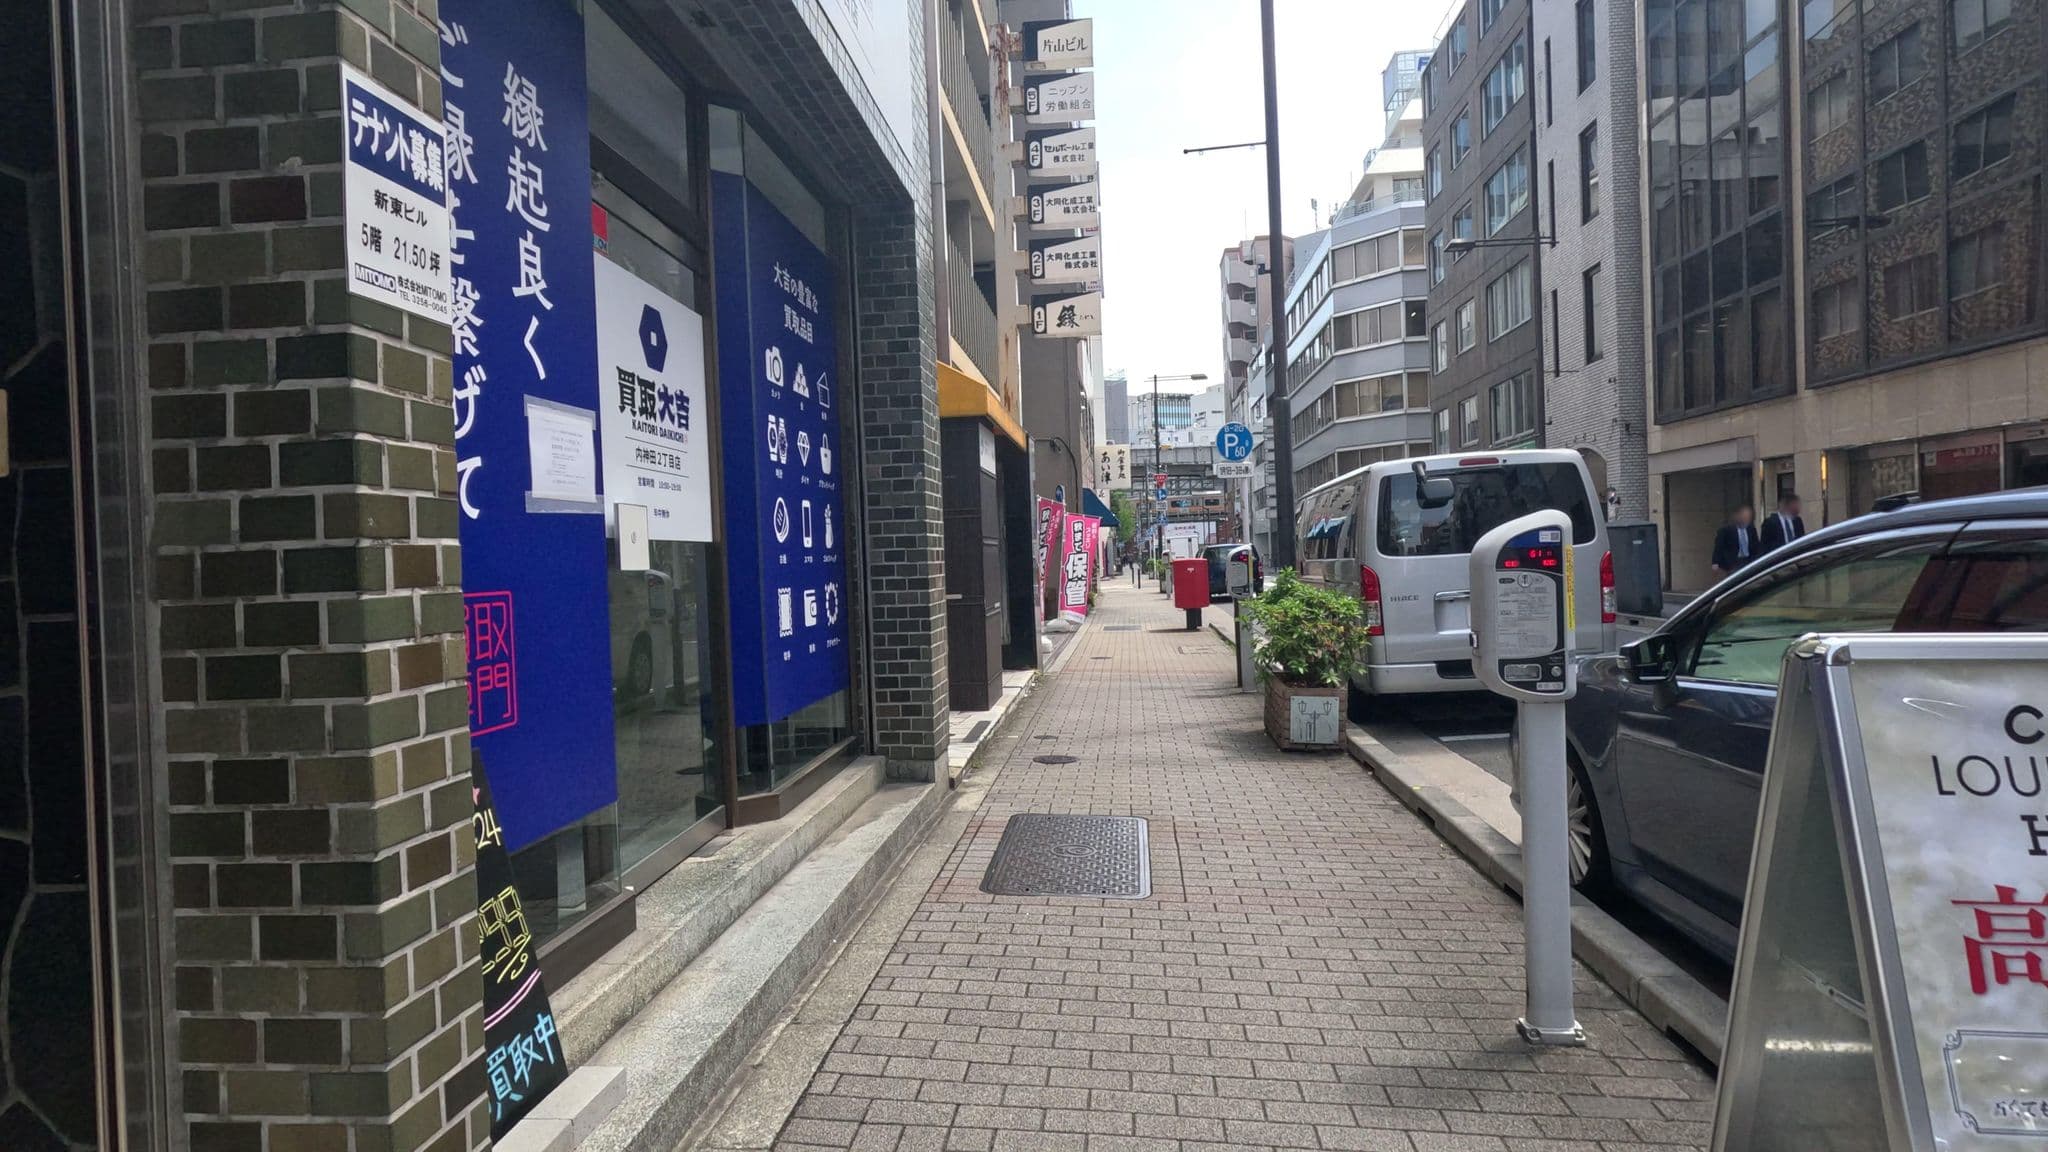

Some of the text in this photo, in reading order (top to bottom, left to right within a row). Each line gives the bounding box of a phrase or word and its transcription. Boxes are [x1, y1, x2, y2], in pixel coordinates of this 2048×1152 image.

[1042, 37, 1088, 52] 片山ビル
[1027, 90, 1037, 112] 5F
[1045, 98, 1092, 112] 労働組合
[350, 97, 444, 193] テナント募集
[1030, 143, 1040, 165] 4F
[1053, 154, 1086, 163] 株式会社
[374, 189, 428, 228] 新東ビル
[502, 61, 554, 381] 縁起良く
[1031, 197, 1042, 221] 3F
[1063, 204, 1096, 214] 株式会社
[361, 223, 383, 256] 5階
[1032, 252, 1042, 275] 2F
[1065, 259, 1098, 270] 株式会社
[355, 265, 396, 291] MITOMO
[398, 275, 448, 303] 株式会社MITOMO
[773, 262, 819, 314] 大吉の豊富な
[400, 291, 411, 302] TEL
[783, 304, 814, 345] 買取品目
[1034, 309, 1044, 333] 1F
[616, 366, 690, 431] 買取大吉
[632, 419, 684, 444] KAITORI DAIKICHI
[1224, 433, 1246, 458] P 60
[635, 446, 681, 471] 内神田2丁目店
[1101, 451, 1112, 485] あい津
[464, 602, 509, 663] 取
[1931, 755, 2048, 797] LOU
[1952, 884, 2048, 995] 高
[487, 1013, 556, 1121] 買取中
